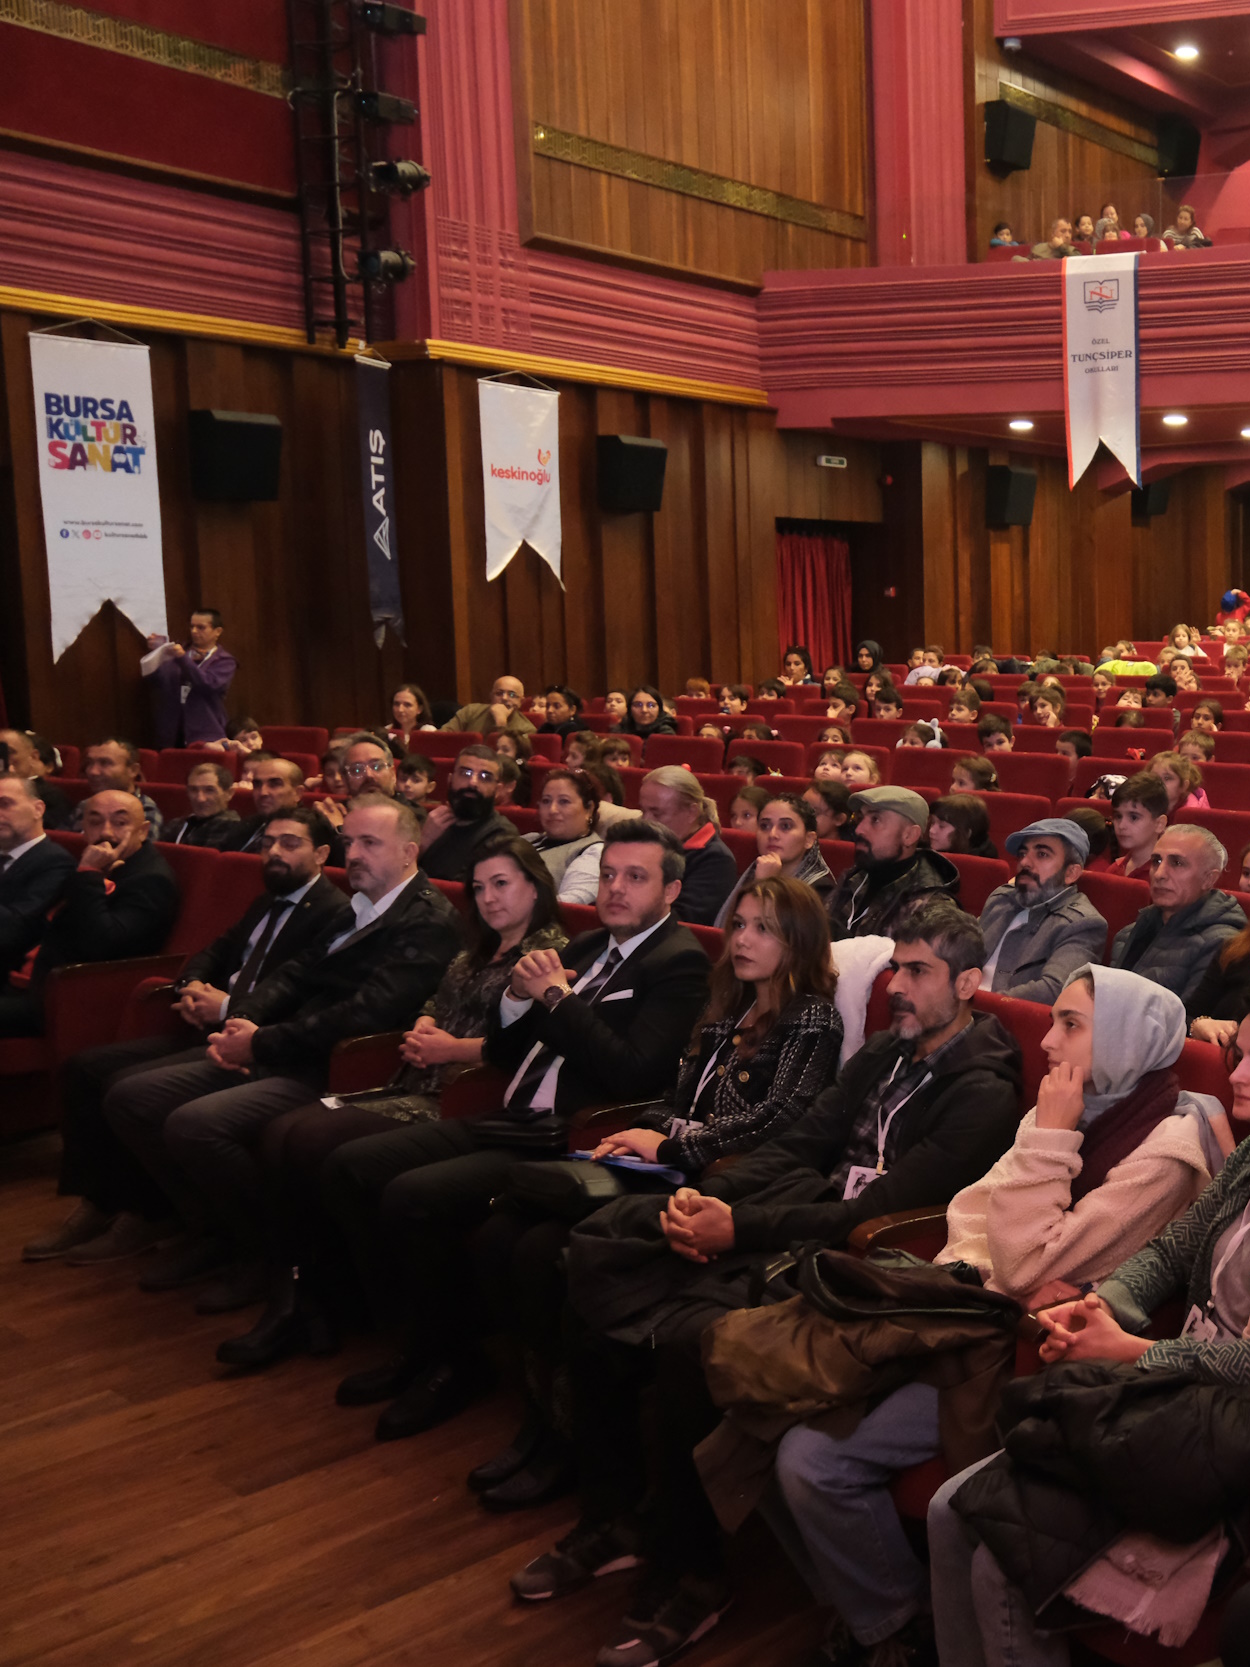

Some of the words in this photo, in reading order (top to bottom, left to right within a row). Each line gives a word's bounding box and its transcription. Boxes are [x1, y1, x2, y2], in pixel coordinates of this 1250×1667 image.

[1091, 338, 1111, 346] ÖZEL
[1071, 349, 1133, 363] TUNÇSİPER
[1084, 365, 1119, 374] OKULLARI
[44, 392, 135, 423] BURSA
[46, 416, 138, 446] KÜLTÜR
[48, 440, 146, 475] SANAT
[369, 428, 387, 517] ATIŞ
[490, 463, 552, 486] keskinoğlu
